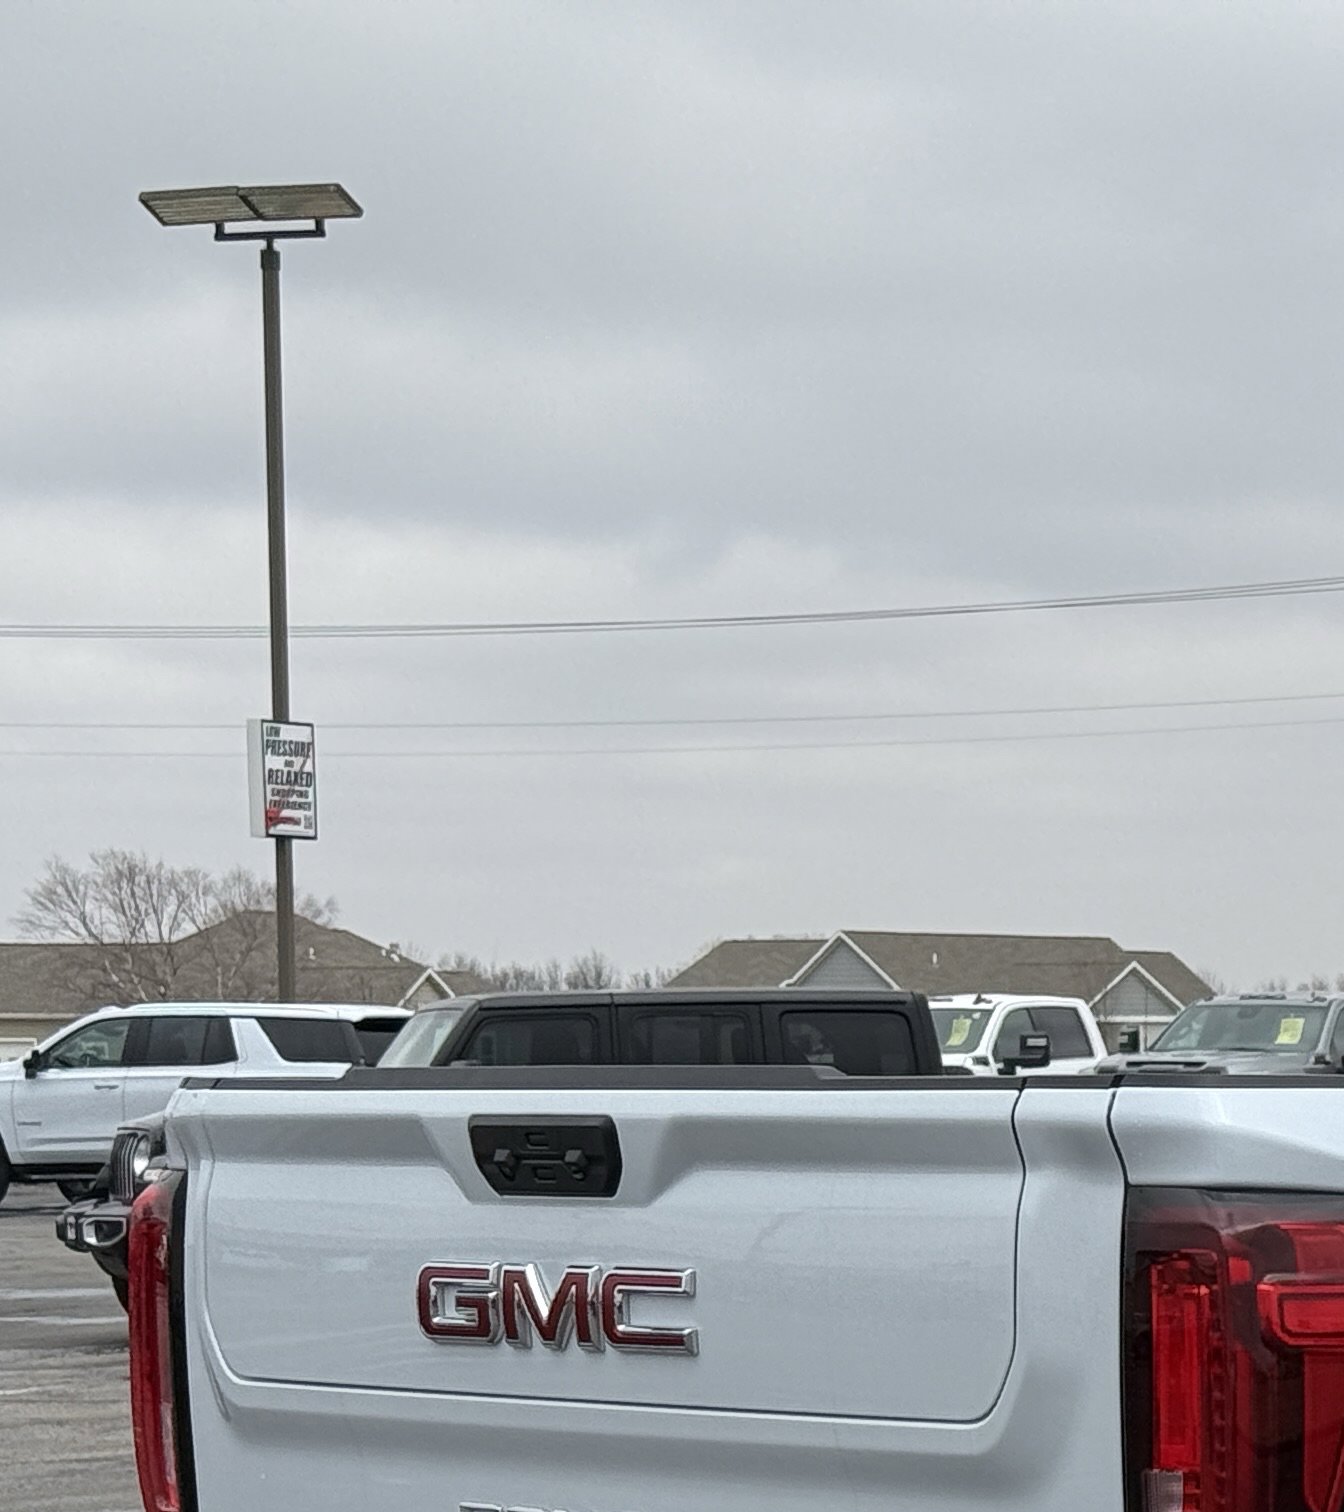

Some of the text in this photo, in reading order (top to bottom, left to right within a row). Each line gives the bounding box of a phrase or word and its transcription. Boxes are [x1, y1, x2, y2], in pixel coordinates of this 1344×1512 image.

[266, 726, 281, 737] LOW
[265, 739, 311, 758] PRESSURE
[267, 768, 313, 788] RELAXED
[415, 1261, 699, 1355] GMC
